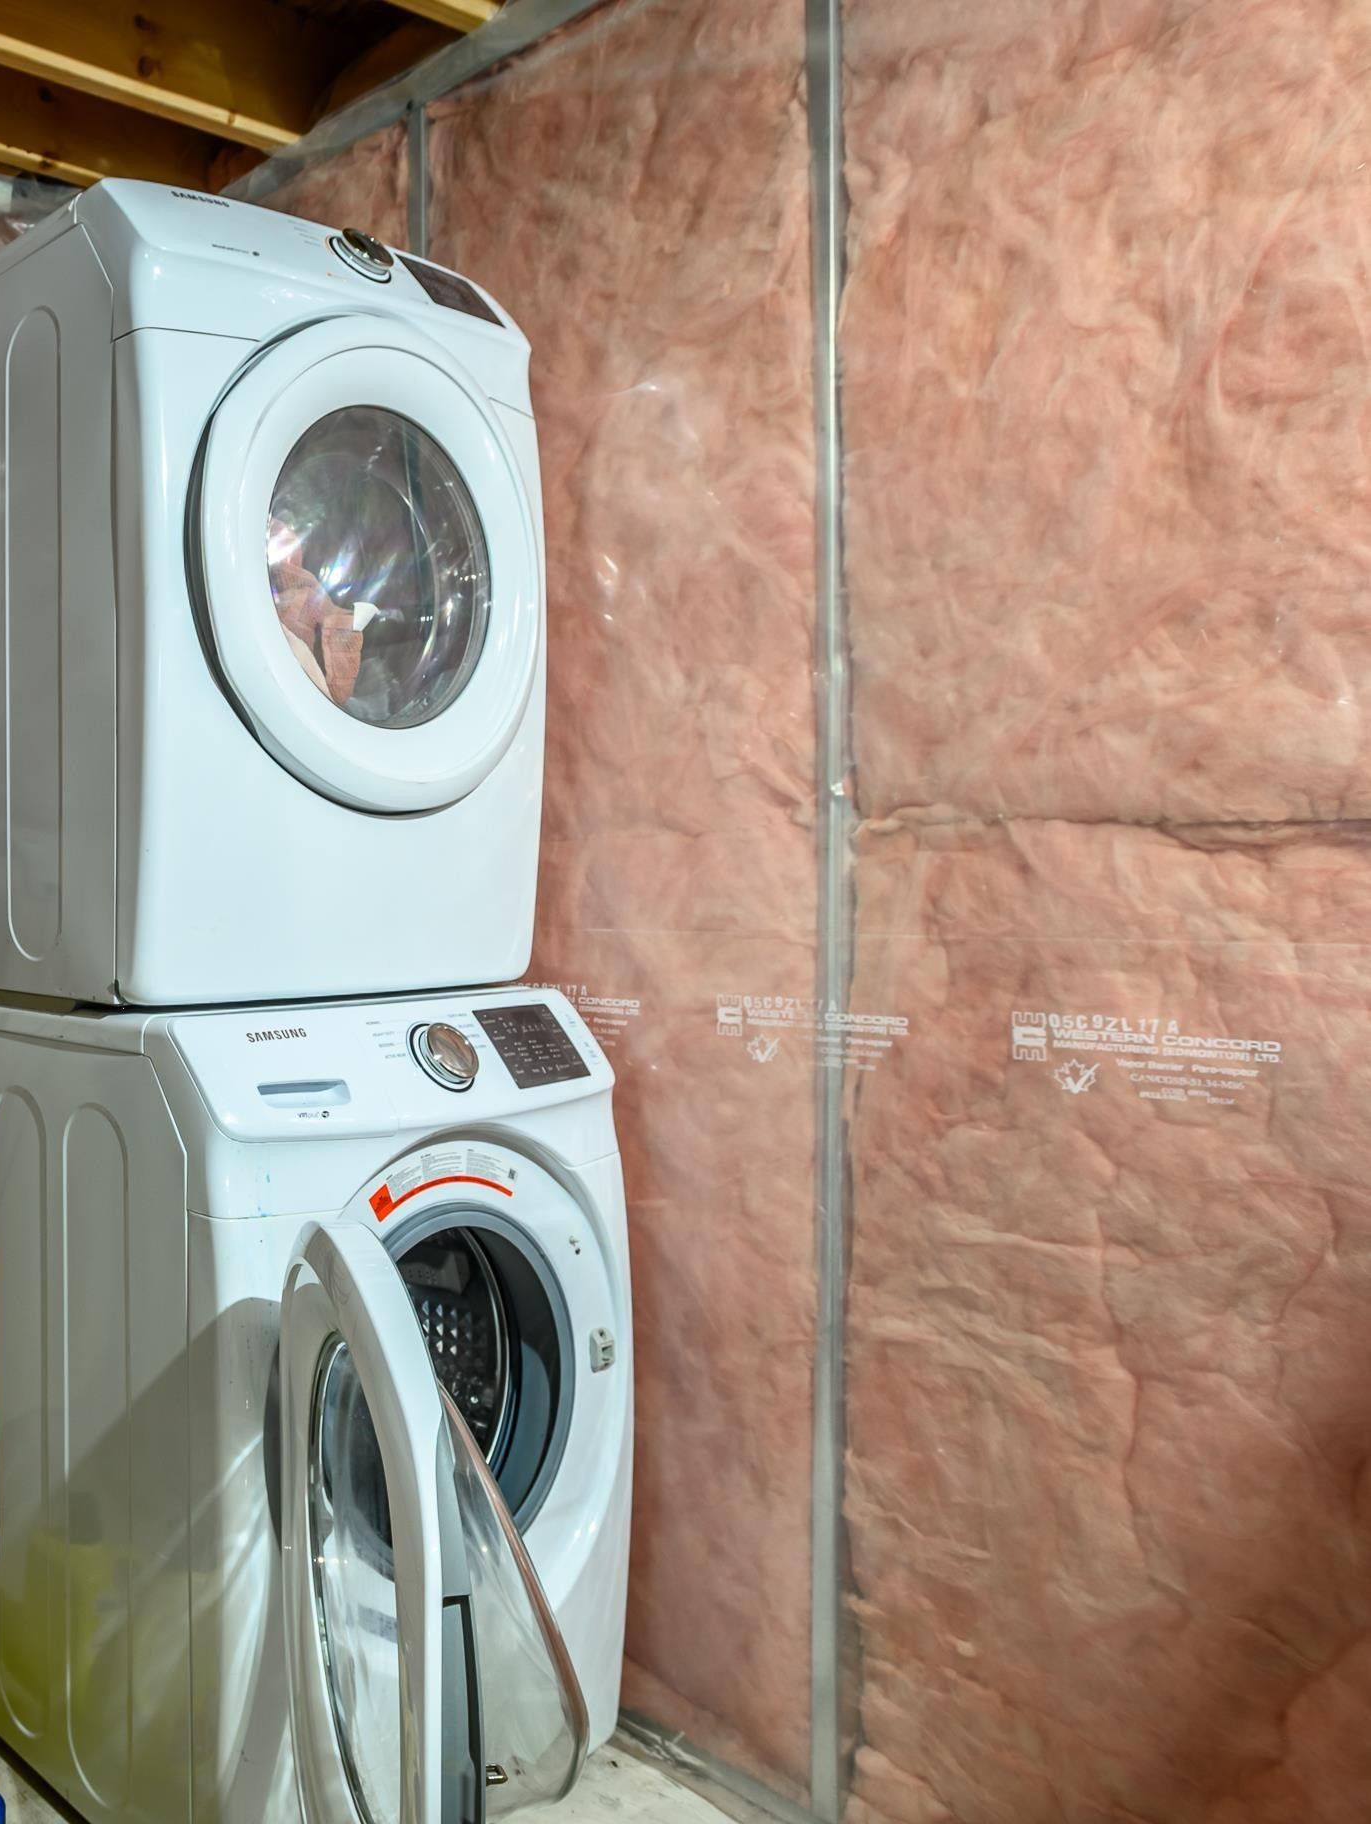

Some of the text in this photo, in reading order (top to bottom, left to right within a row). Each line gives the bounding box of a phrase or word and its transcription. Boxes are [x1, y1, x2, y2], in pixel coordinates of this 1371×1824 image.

[171, 190, 230, 208] SAMSUNG
[578, 997, 640, 1008] CONCORD
[824, 1013, 909, 1027] CONCORD
[1048, 1013, 1179, 1035] 05C 9ZL 17 A
[246, 1027, 307, 1043] SAMSUNG
[1052, 1029, 1282, 1052] WESTERN CONCORD
[1254, 1053, 1283, 1065] LTD.
